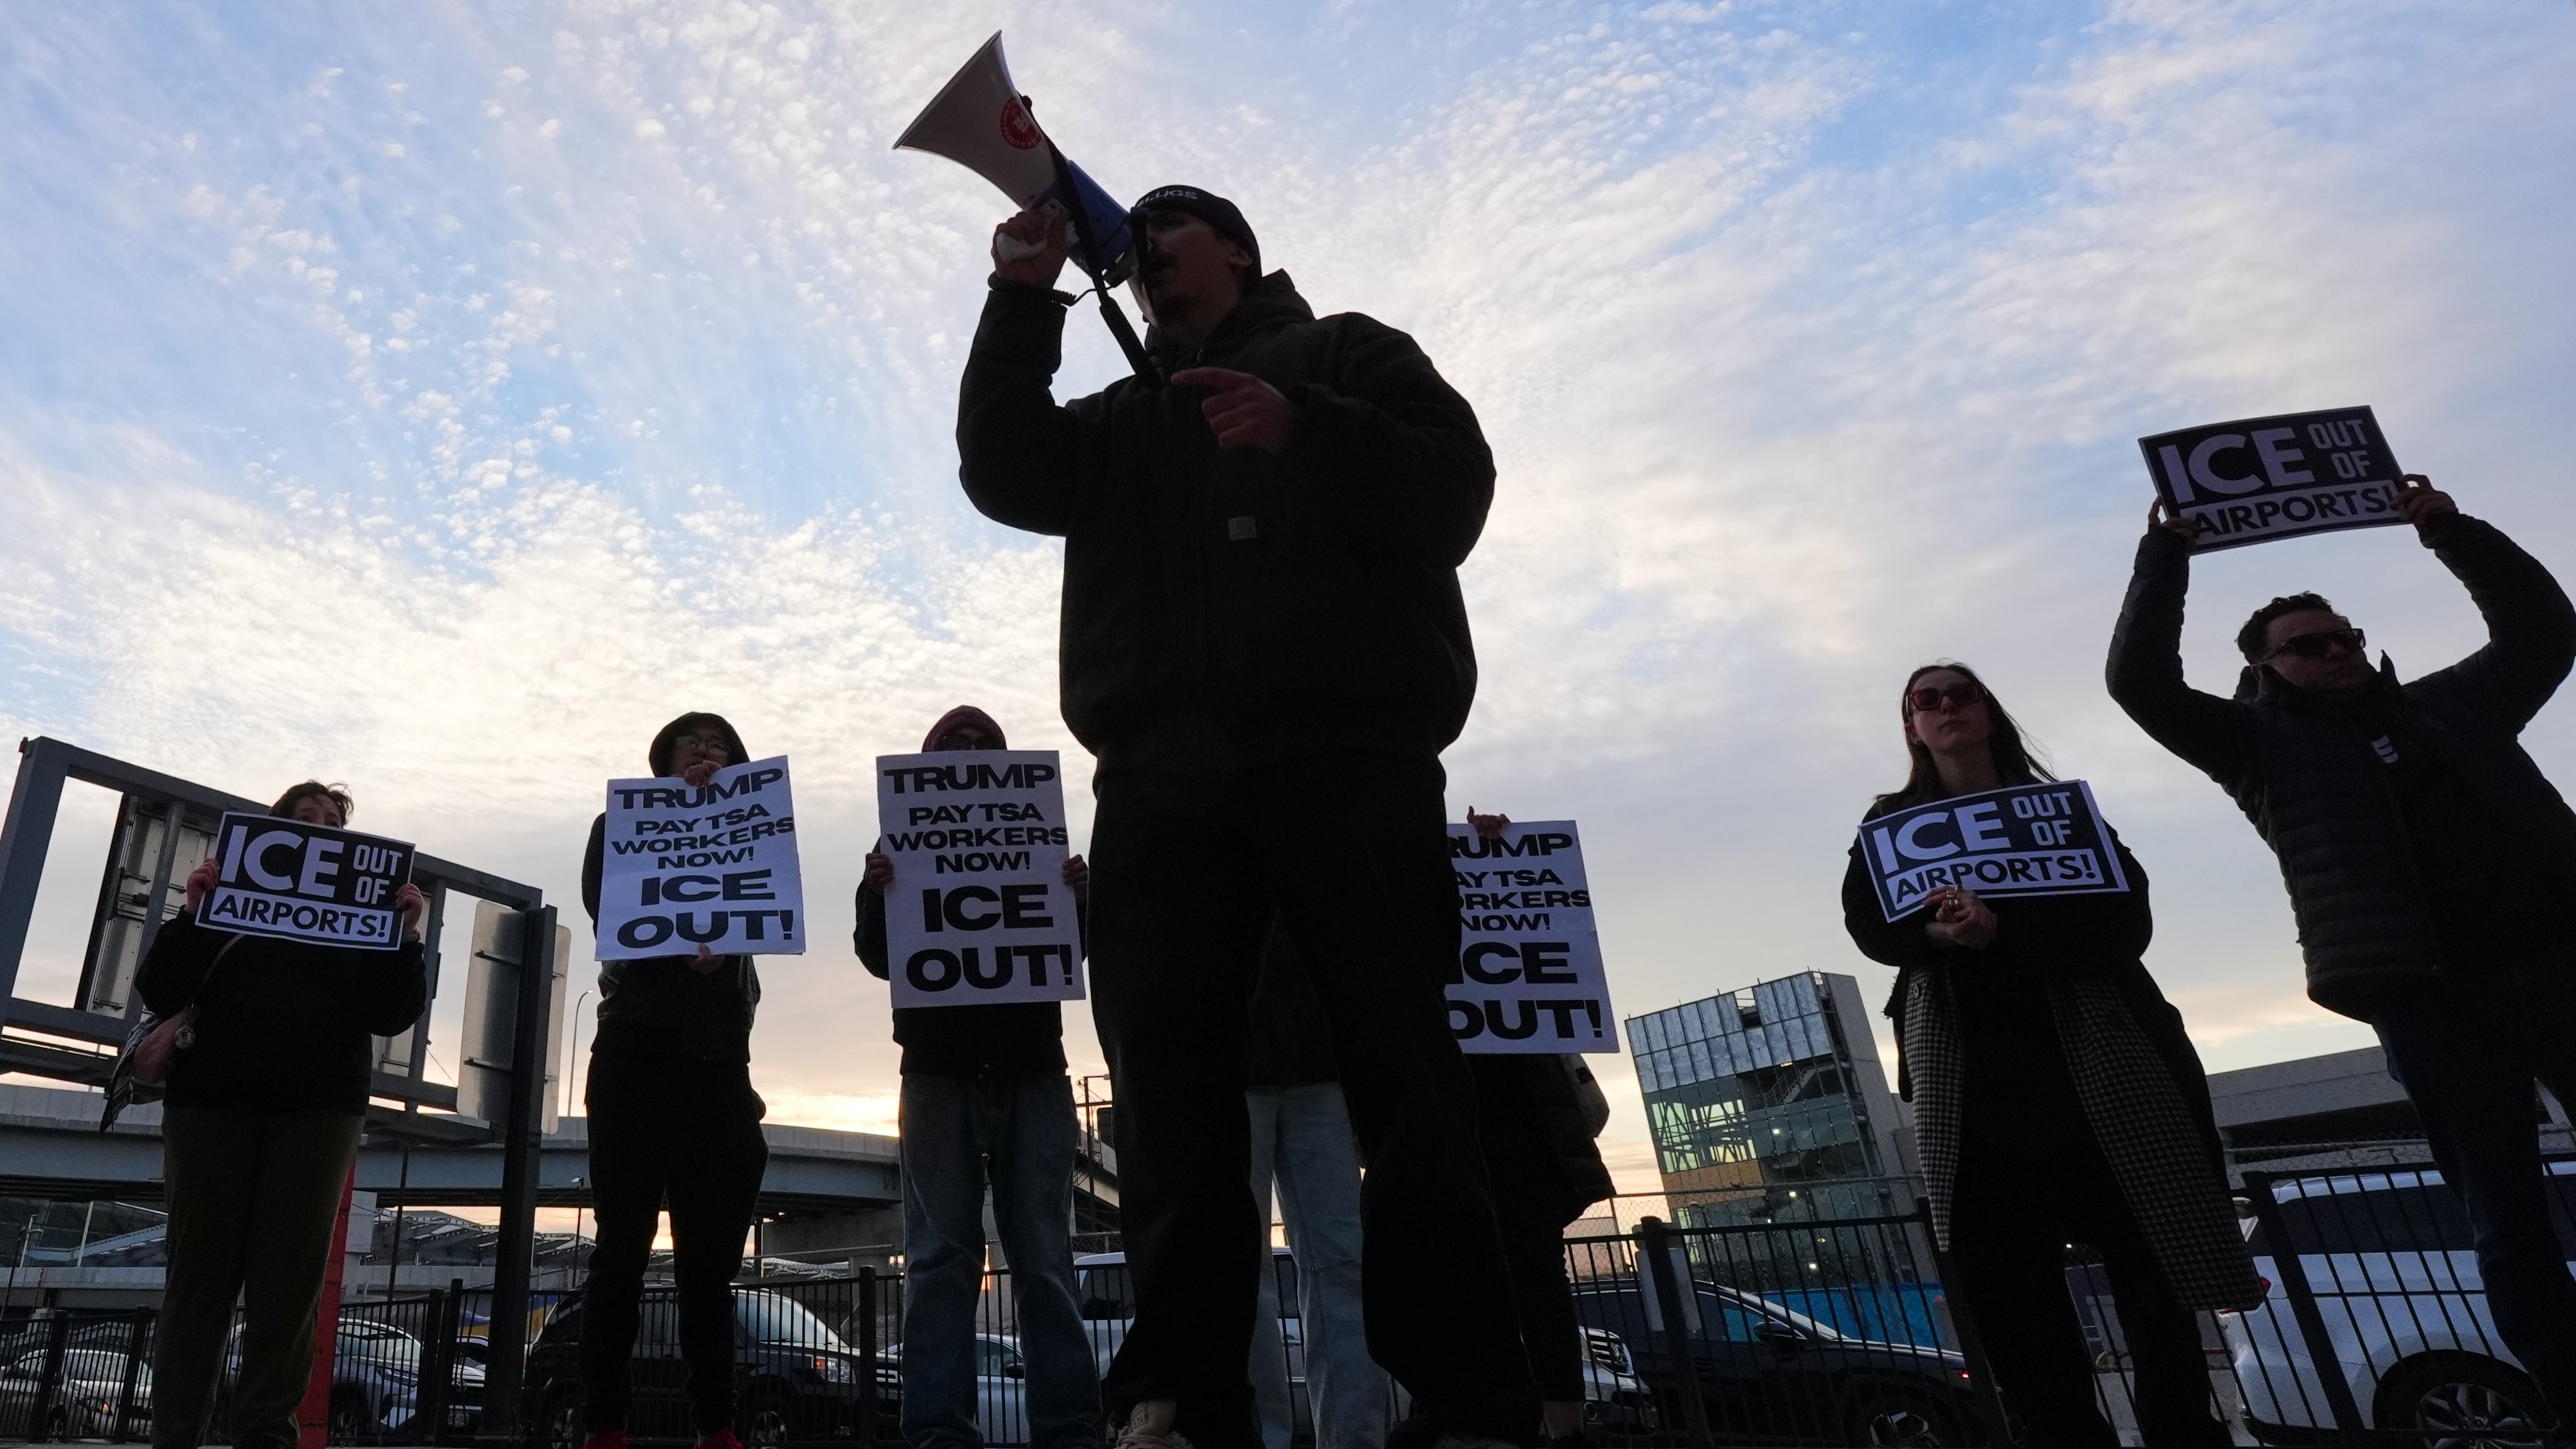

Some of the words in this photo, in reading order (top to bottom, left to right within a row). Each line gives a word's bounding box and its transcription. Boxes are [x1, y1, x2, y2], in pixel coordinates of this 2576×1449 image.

[2308, 419, 2368, 449] OUT
[2159, 427, 2316, 504] ICE
[2331, 450, 2370, 479] OF
[2194, 485, 2397, 536] AIRPORTS!
[614, 768, 783, 809] TRUMP
[884, 764, 1055, 793] TRUMP
[636, 818, 703, 835] PAY
[705, 803, 770, 829] TSA
[909, 804, 974, 826] PAY
[979, 803, 1044, 822] TSA
[2012, 792, 2072, 819] OUT
[612, 817, 794, 855] WORKERS
[886, 827, 1068, 852] WORKERS
[1448, 833, 1572, 859] UMP
[1873, 801, 2012, 875] ICE
[2032, 820, 2071, 846] OF
[220, 825, 345, 897] ICE
[353, 845, 403, 875] OUT
[658, 846, 754, 869] NOW!
[935, 852, 1029, 874] NOW!
[354, 877, 389, 905] OF
[641, 869, 775, 906] ICE
[1457, 872, 1489, 888] AY
[1493, 869, 1564, 887] TSA
[1897, 854, 2096, 904] AIRPORTS!
[213, 894, 387, 937] AIRPORTS!
[922, 884, 1054, 932] ICE
[1459, 890, 1590, 910] RKERS
[617, 910, 793, 948] OUT!
[906, 944, 1073, 992] OUT!
[1447, 1000, 1603, 1040] OUT!
